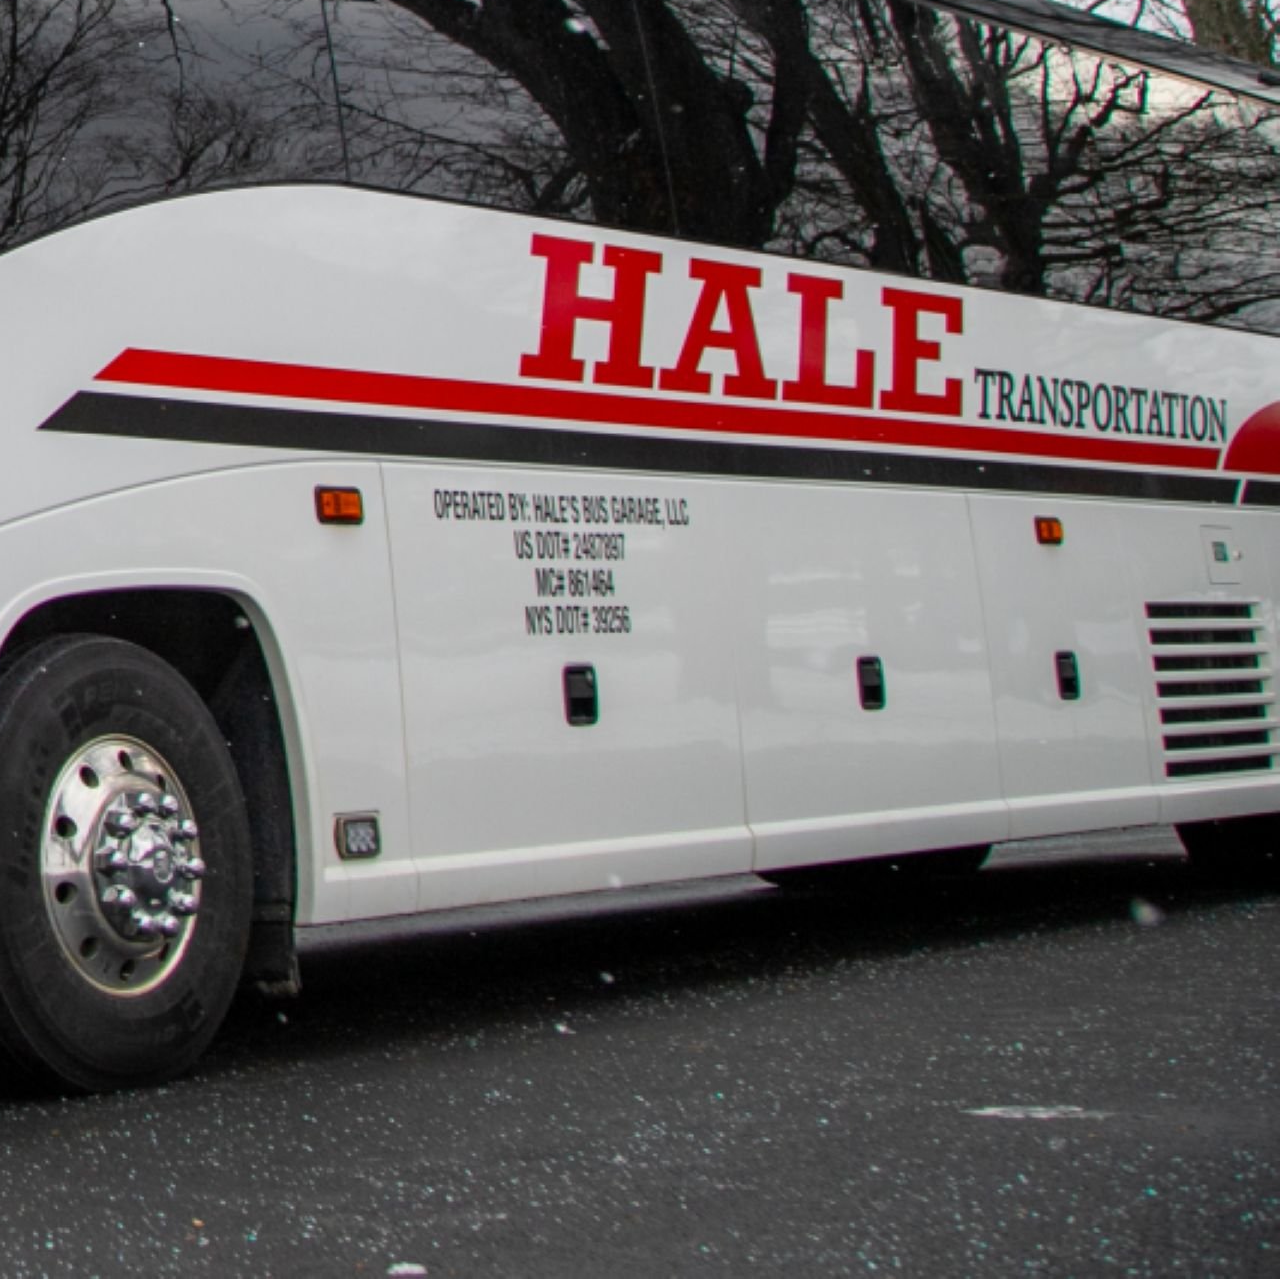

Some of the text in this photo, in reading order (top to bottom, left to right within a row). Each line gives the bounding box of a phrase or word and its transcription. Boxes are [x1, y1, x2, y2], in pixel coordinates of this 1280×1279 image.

[519, 232, 1228, 444] HALE TRANSPORTATION
[433, 489, 689, 529] OPERATED BY: HALE'S BUS GARAGE, LLC
[513, 530, 533, 559] US
[535, 531, 569, 559] DOT#
[535, 568, 565, 597] MC#
[525, 606, 552, 635] NYS
[555, 606, 589, 633] DOT#
